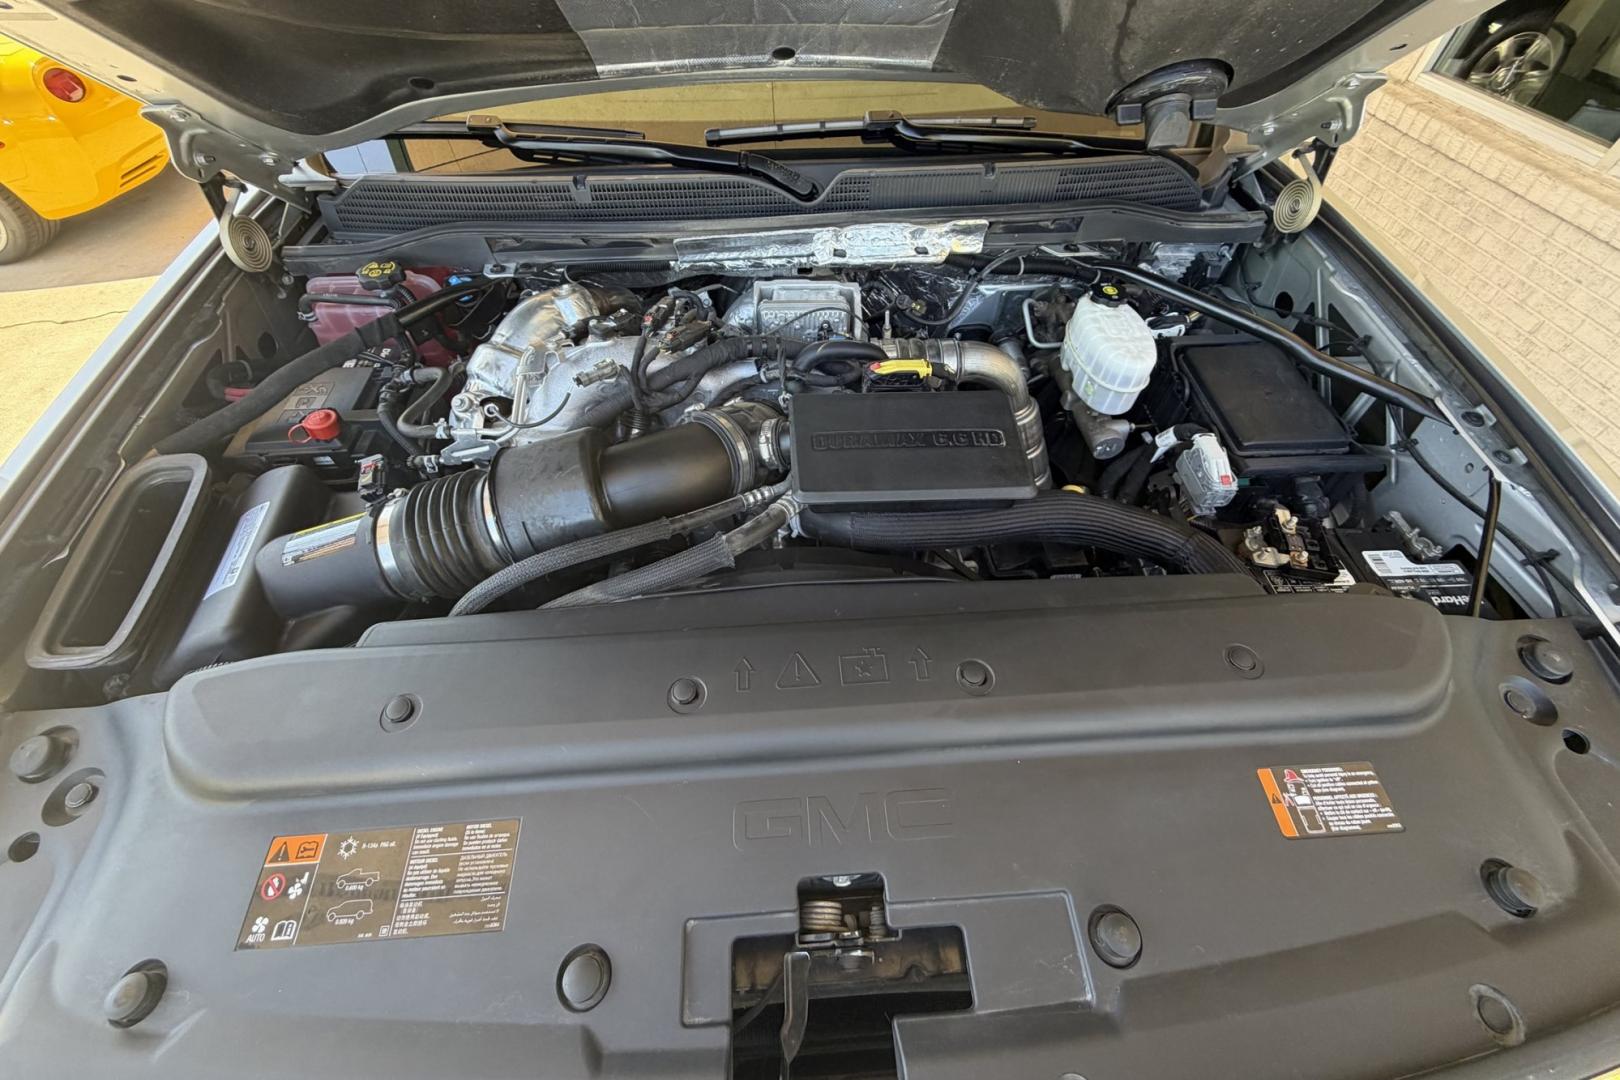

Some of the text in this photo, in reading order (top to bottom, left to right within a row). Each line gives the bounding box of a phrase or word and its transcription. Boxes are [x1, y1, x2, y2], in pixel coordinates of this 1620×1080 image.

[812, 432, 927, 450] DURAMAX
[733, 787, 954, 851] GMC
[245, 934, 266, 944] AUTO
